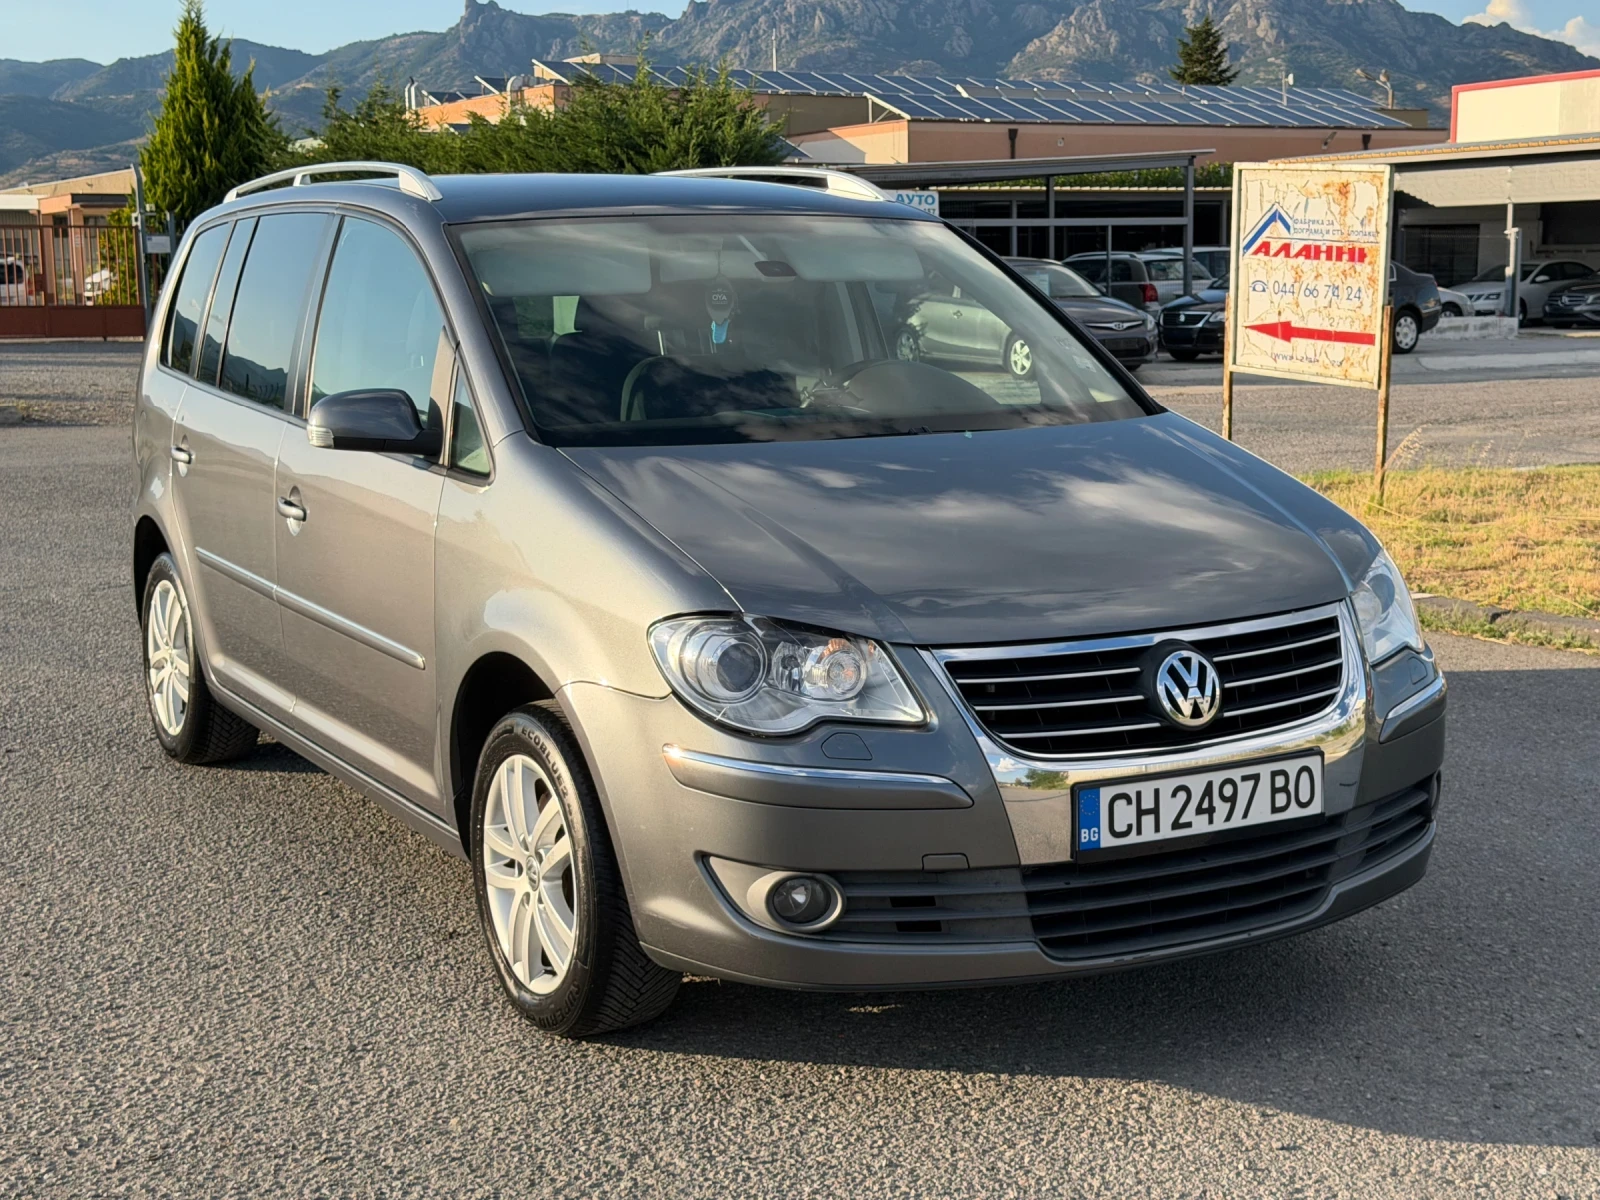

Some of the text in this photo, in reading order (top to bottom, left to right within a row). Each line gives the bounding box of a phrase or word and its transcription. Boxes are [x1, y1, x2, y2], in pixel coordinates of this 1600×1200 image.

[1345, 285, 1362, 301] 24
[1108, 765, 1315, 838] CH 2497 BO
[1081, 827, 1099, 843] BG
